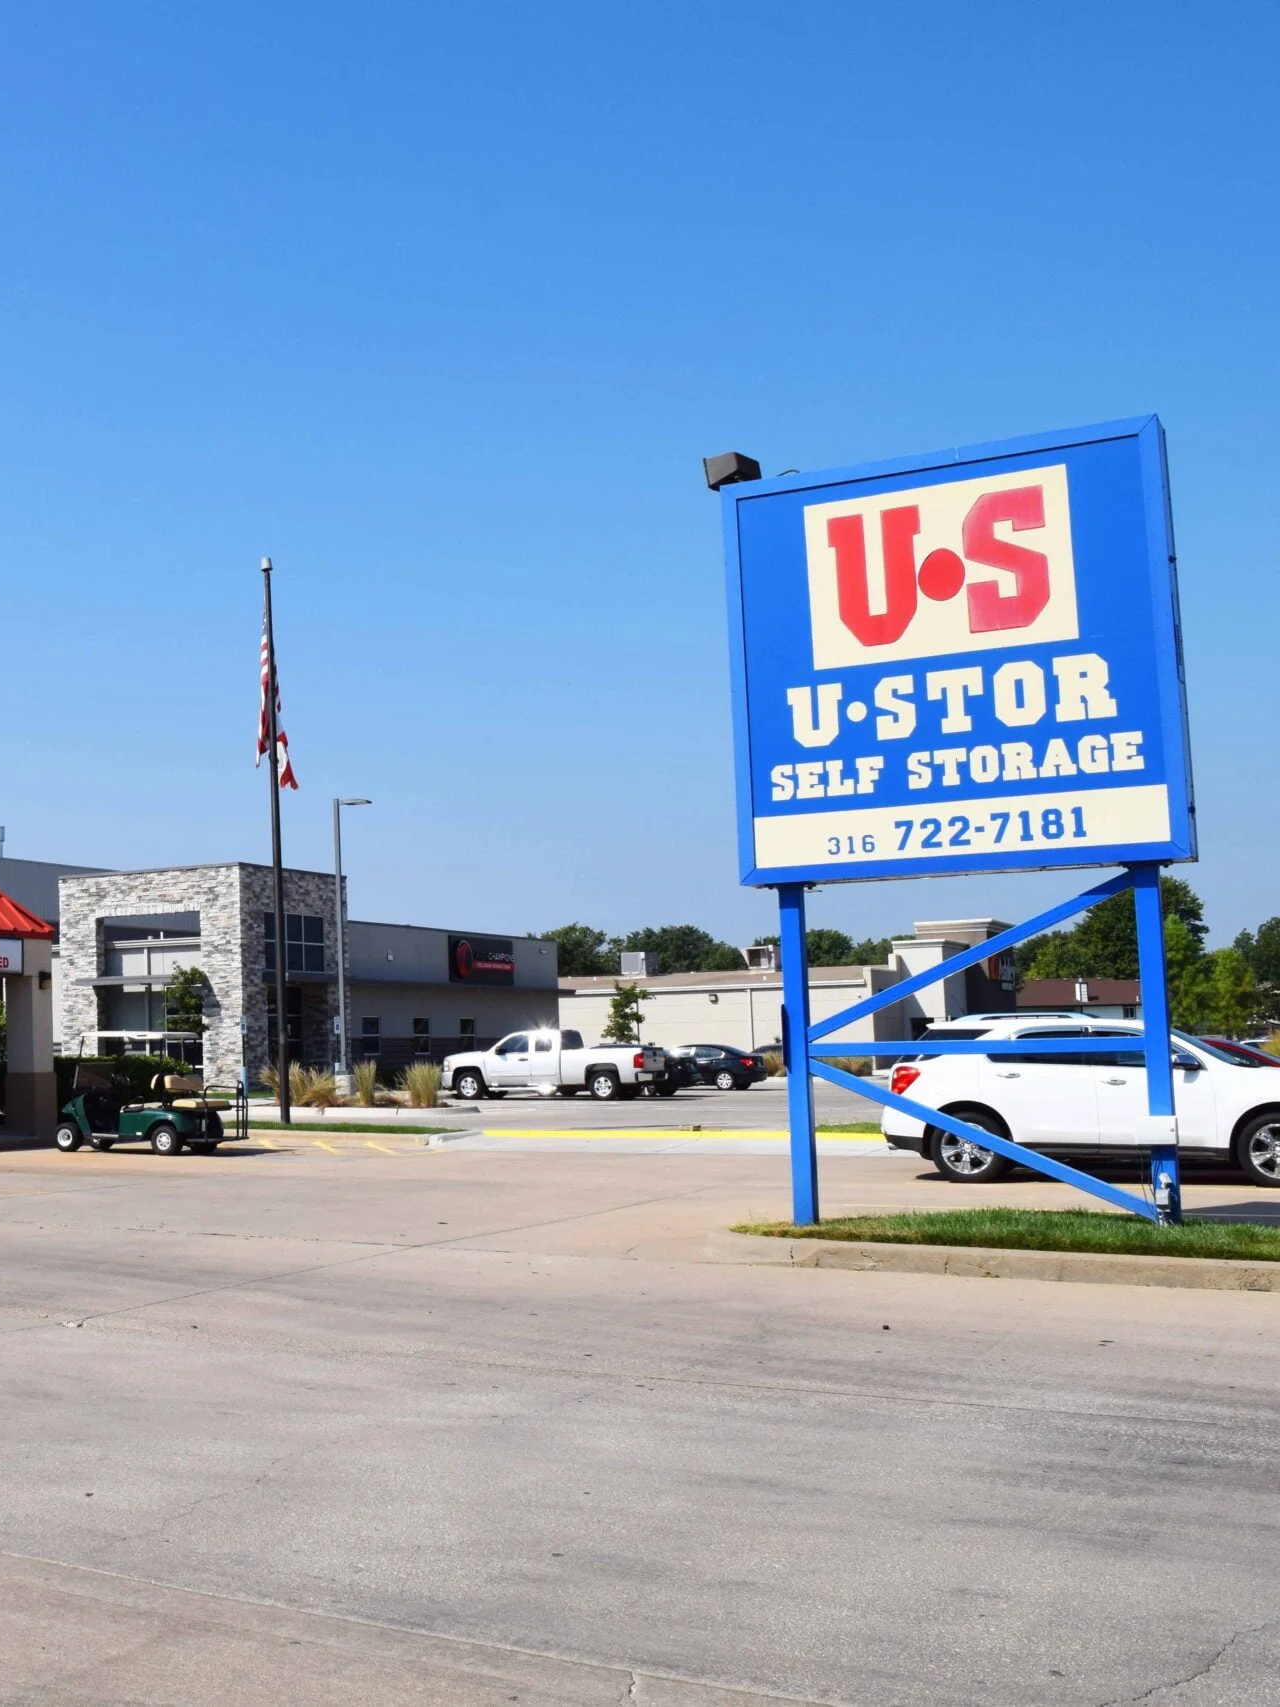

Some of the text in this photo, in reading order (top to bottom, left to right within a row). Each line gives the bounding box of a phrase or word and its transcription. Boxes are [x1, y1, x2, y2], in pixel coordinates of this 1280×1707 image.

[771, 731, 1145, 801] SELF STORAGE
[827, 806, 1088, 856] 316 722-7181
